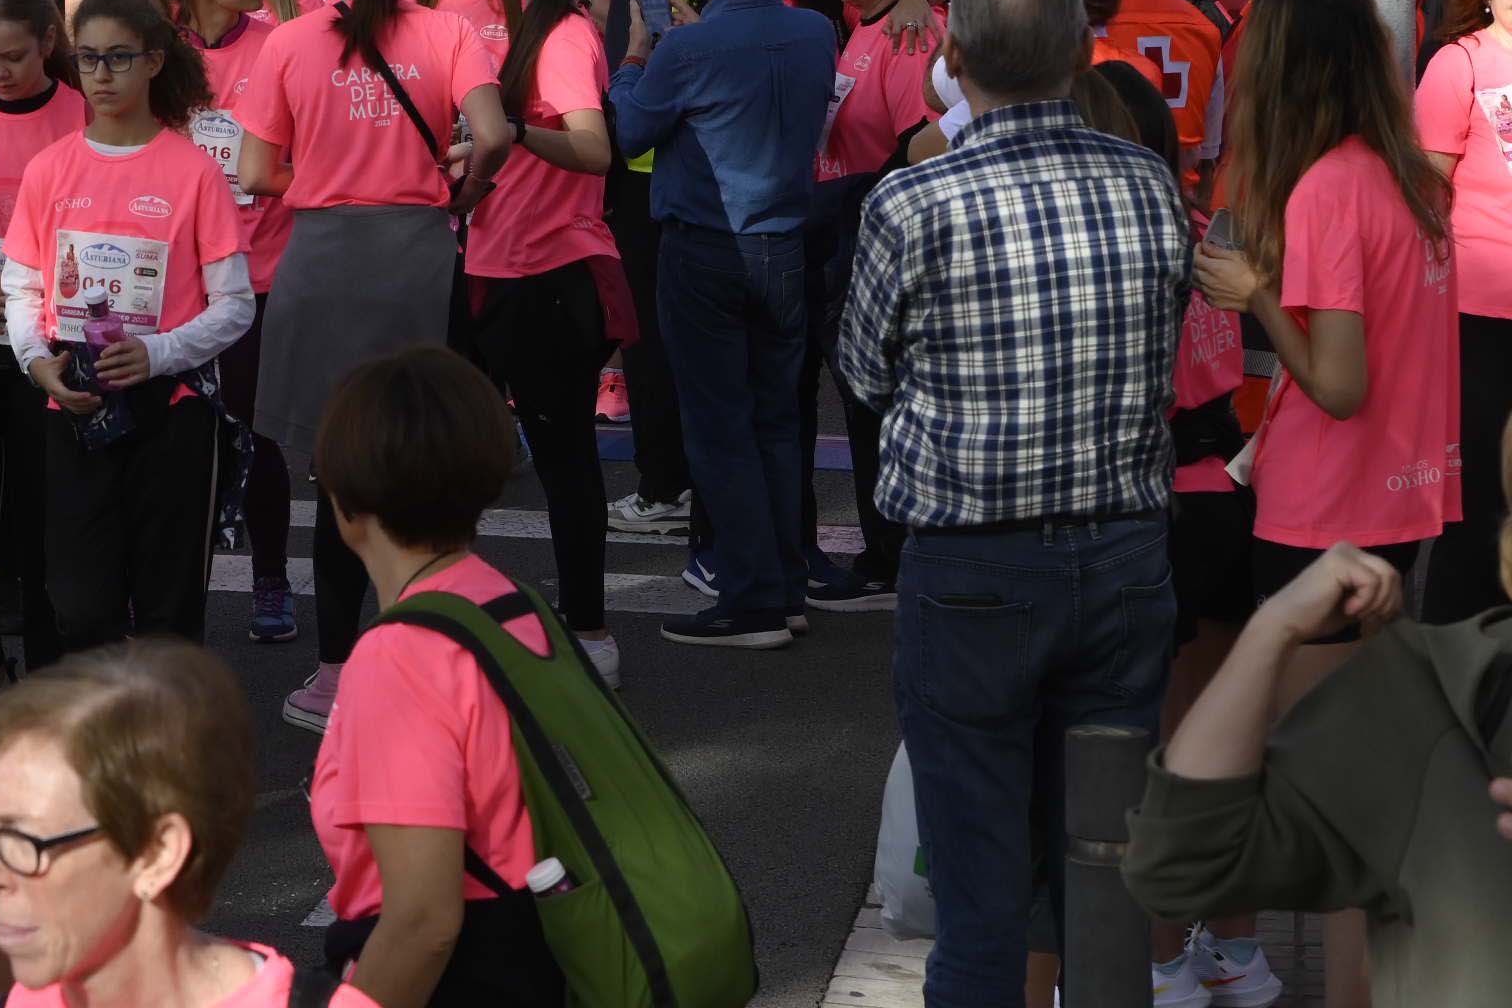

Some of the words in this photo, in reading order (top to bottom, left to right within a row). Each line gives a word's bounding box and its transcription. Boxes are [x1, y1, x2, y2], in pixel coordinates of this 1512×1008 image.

[331, 63, 421, 87] CARRA
[351, 84, 376, 103] DE
[383, 85, 398, 98] L
[349, 99, 403, 121] MUJE
[198, 122, 235, 134] ASTURIANA
[131, 202, 169, 215] ASTURIANA
[85, 251, 126, 265] ASTURIANA
[136, 254, 159, 262] SUMA
[1190, 322, 1208, 342] DE
[1211, 313, 1231, 330] LA
[1190, 331, 1236, 368] MUJER
[1387, 467, 1441, 492] OYSHO
